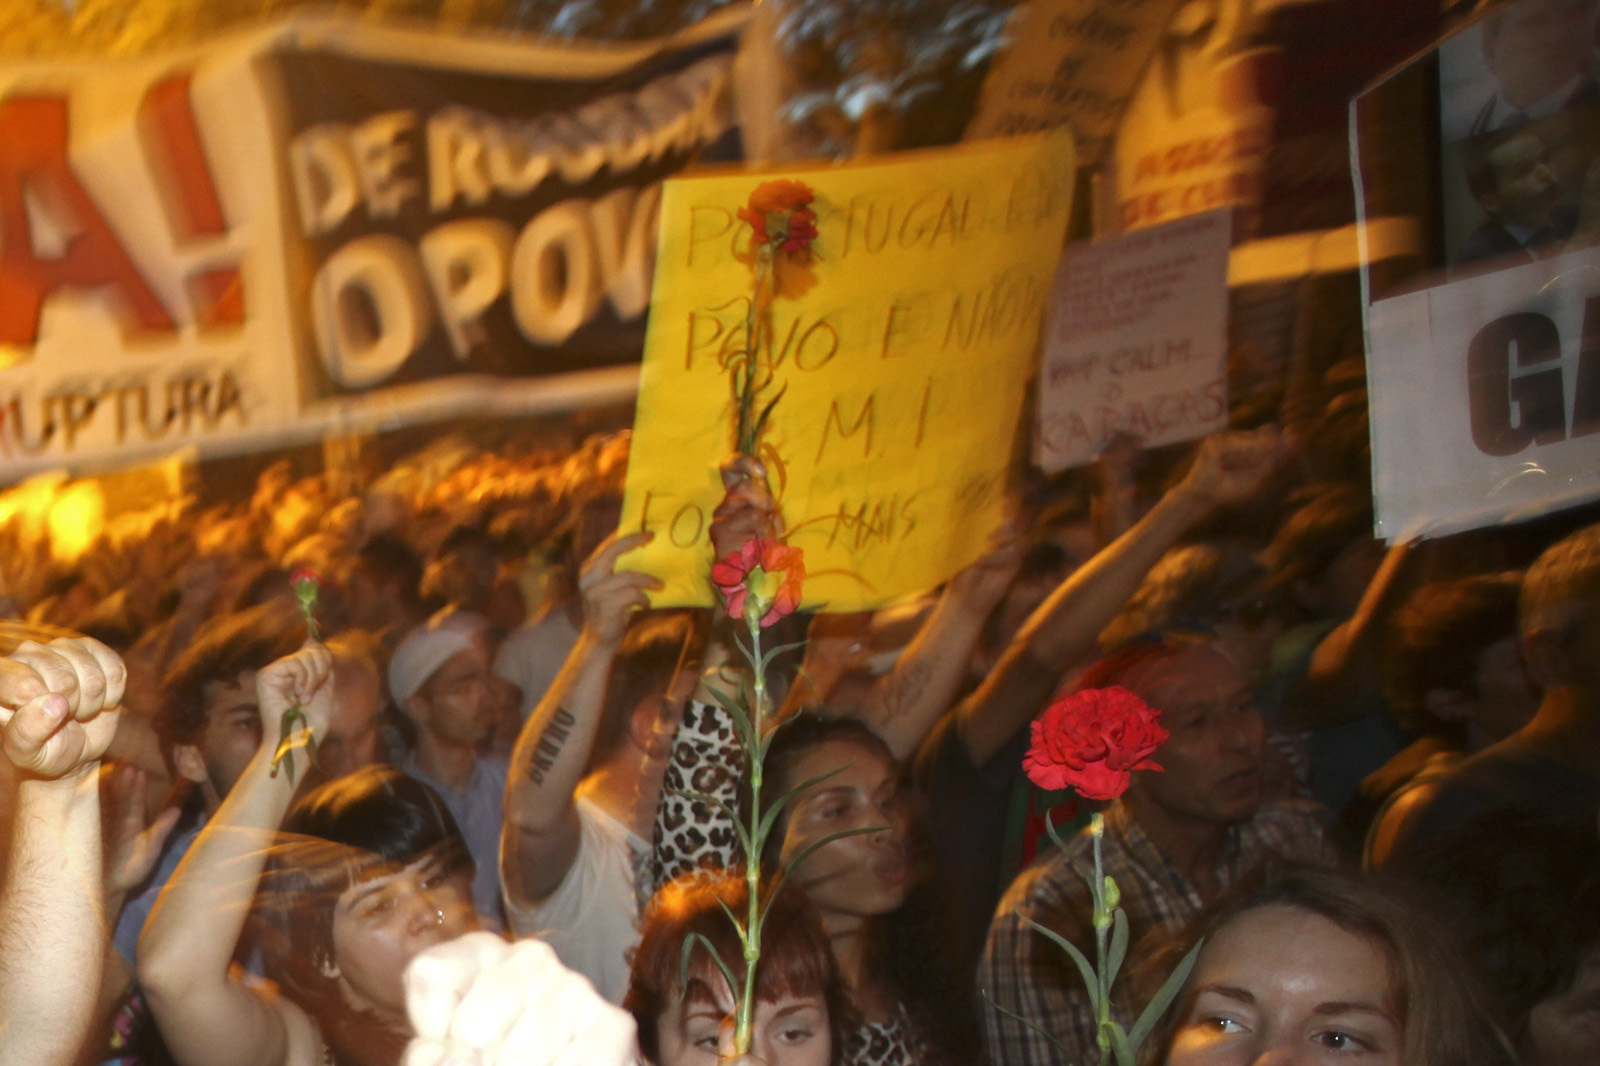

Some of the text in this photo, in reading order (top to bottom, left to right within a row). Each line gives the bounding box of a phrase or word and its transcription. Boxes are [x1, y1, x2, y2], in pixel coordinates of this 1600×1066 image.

[311, 184, 662, 388] O POV
[687, 192, 974, 267] POTUGAL
